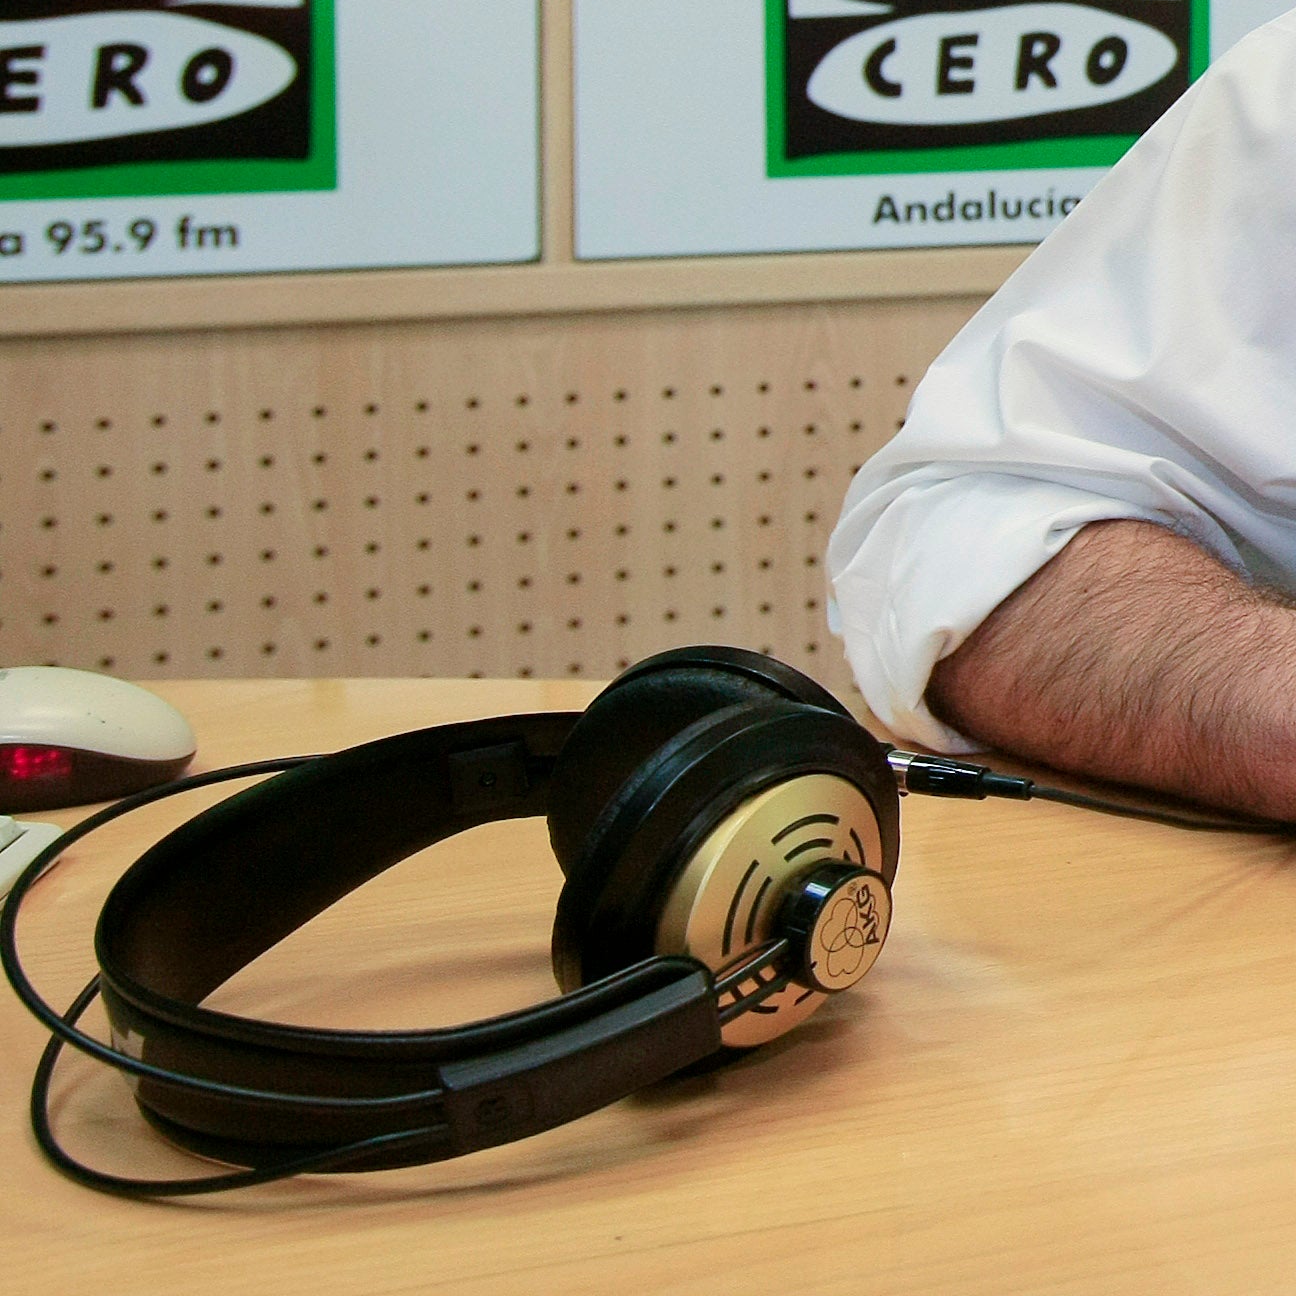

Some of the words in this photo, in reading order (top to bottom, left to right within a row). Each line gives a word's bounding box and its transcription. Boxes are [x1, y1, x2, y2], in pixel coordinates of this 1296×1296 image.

[863, 31, 1129, 97] CERO
[44, 217, 157, 255] 95.9
[174, 213, 239, 249] fm
[856, 884, 880, 945] AKG
